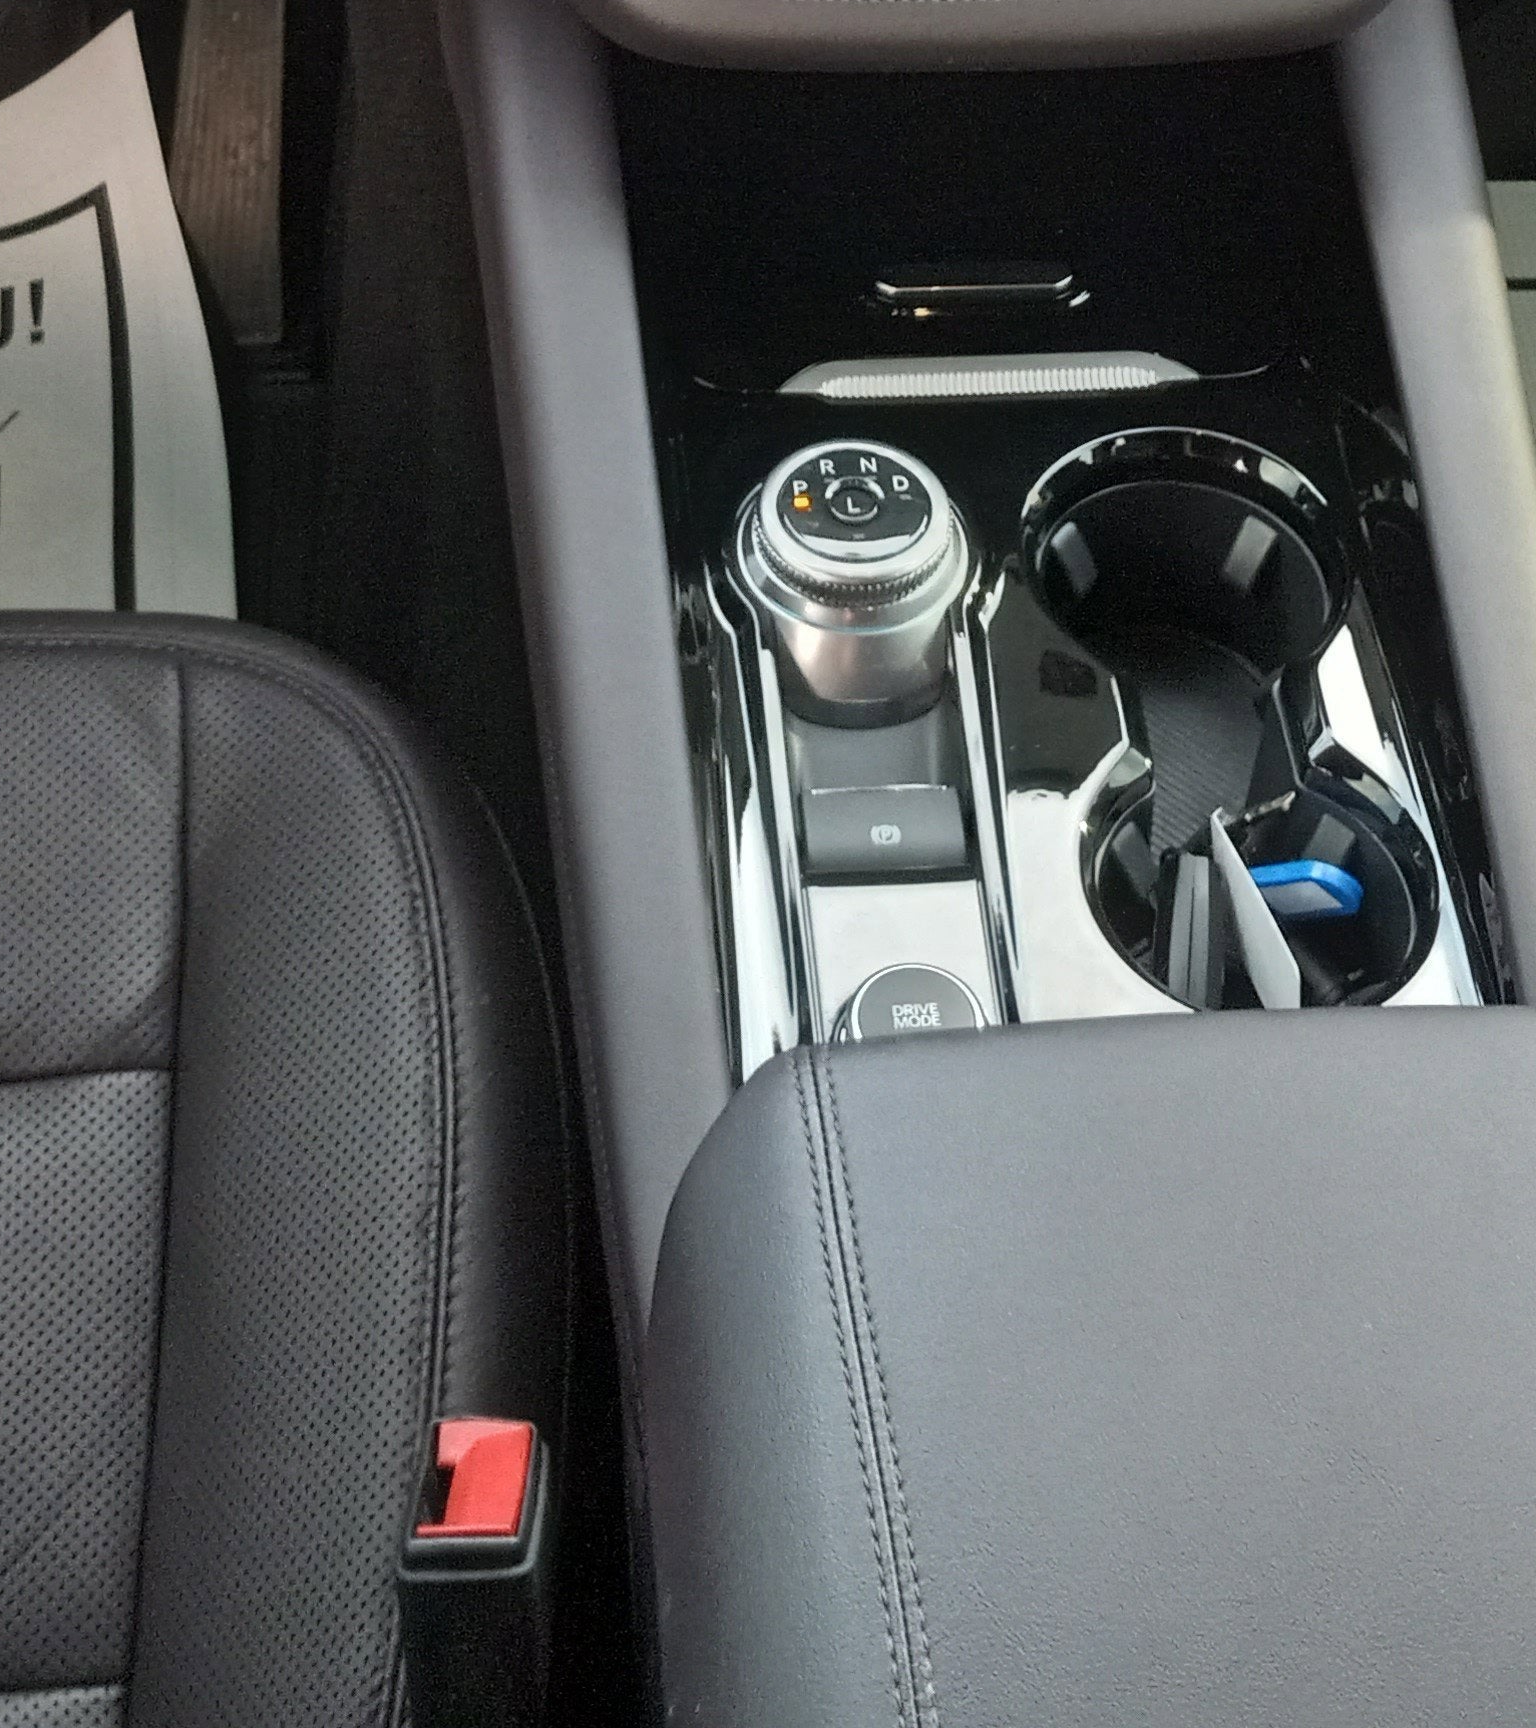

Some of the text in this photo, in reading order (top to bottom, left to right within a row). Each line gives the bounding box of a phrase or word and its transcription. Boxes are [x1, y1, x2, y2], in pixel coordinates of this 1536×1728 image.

[792, 457, 910, 495] P R N D
[846, 496, 862, 514] L
[891, 1002, 939, 1017] DRIVE
[893, 1014, 942, 1030] MODE
